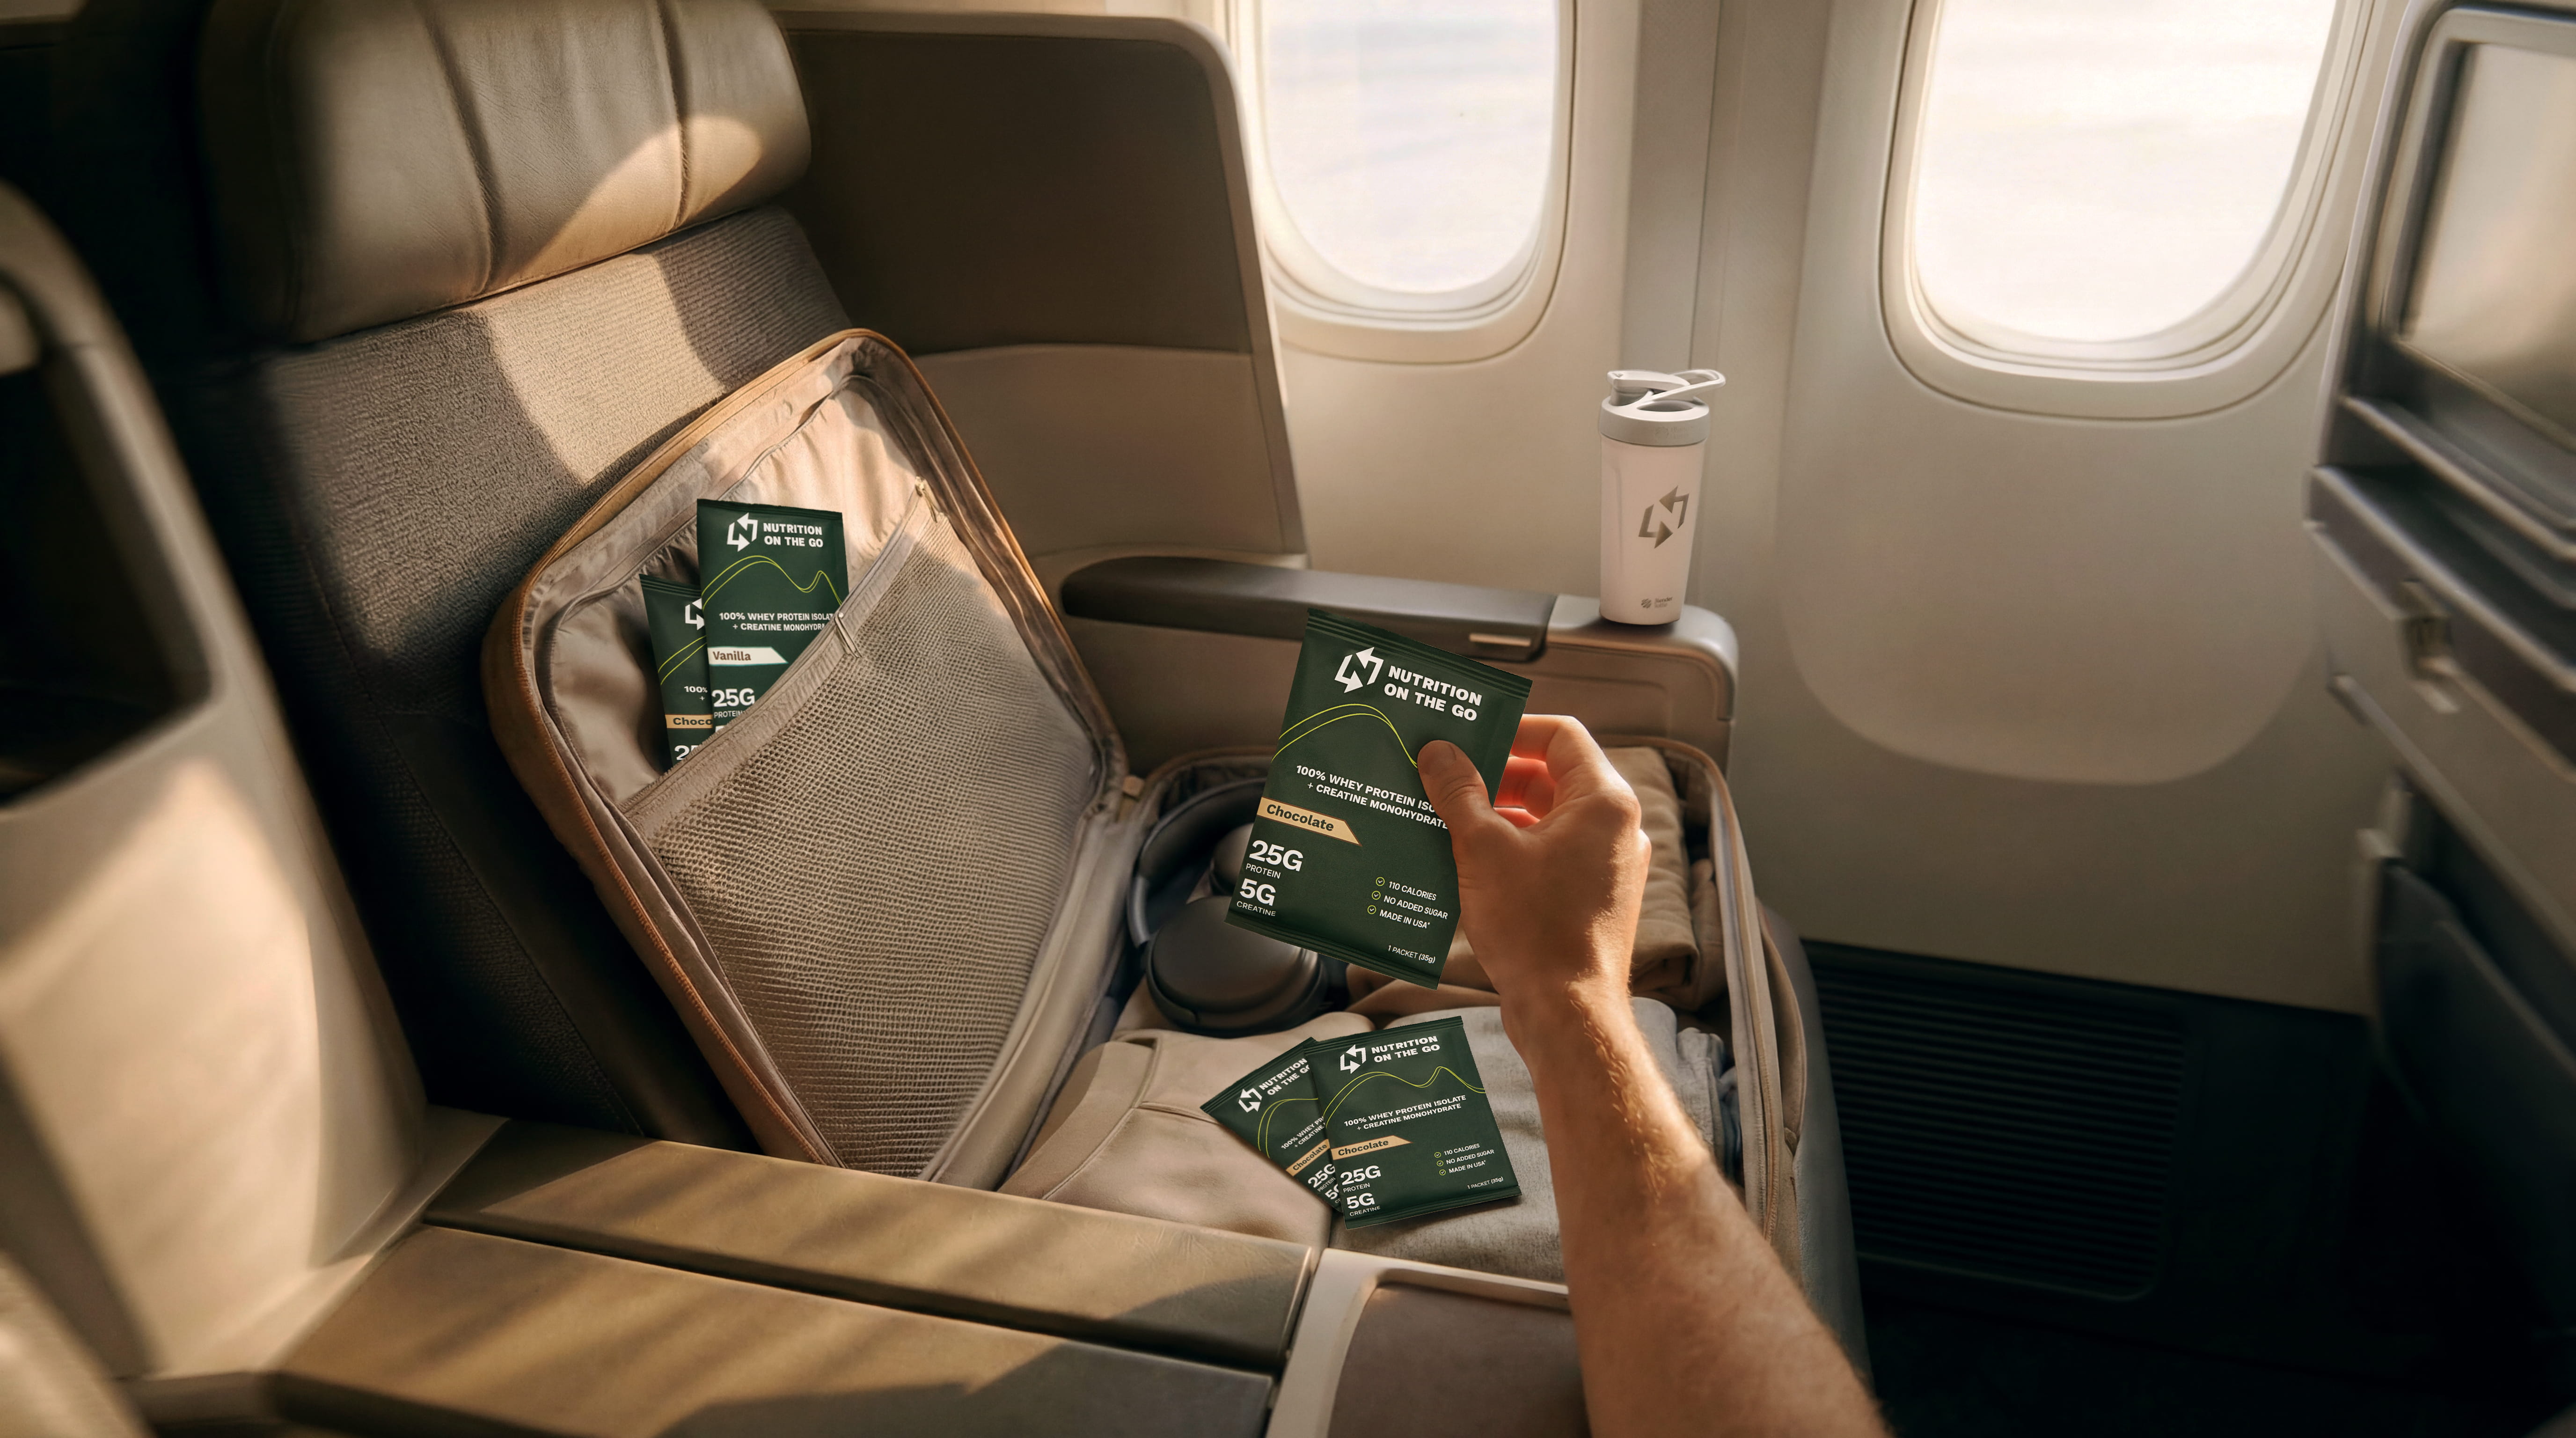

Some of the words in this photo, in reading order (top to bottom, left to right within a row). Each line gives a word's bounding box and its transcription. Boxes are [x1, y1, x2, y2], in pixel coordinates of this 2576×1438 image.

[763, 523, 822, 535] NUTRITION
[764, 536, 781, 545] ON
[784, 537, 805, 546] THE
[809, 538, 823, 547] GO
[713, 651, 751, 660] Vanilla
[1389, 666, 1482, 706] NUTRITION
[711, 688, 755, 707] 25G
[1384, 683, 1409, 700] ON
[1415, 692, 1445, 712] THE
[1452, 704, 1477, 720] GO
[1297, 765, 1325, 780] 100%
[1330, 774, 1363, 791] WHEY
[1365, 785, 1415, 807] PROTEIN
[1317, 784, 1367, 806] CREATINE
[1267, 805, 1333, 831] Chocolate
[1249, 841, 1303, 871] 25G
[1246, 864, 1281, 879] PROTEIN
[1240, 879, 1275, 906] 5G
[1402, 886, 1436, 900] CALORIES
[1237, 901, 1276, 916] CREATINE
[1380, 910, 1403, 922] MADE
[1384, 895, 1396, 904] NO
[1397, 900, 1423, 912] ADDED
[1424, 908, 1448, 919] SUGAR
[1392, 947, 1418, 958] PACKET
[1419, 954, 1435, 963] (35g)
[1371, 1036, 1437, 1053] NUTRITION
[1374, 1054, 1391, 1062] ON
[1395, 1049, 1418, 1058] THE
[1422, 1043, 1440, 1052] GO
[1259, 1058, 1308, 1091] NUTRITION
[1267, 1085, 1282, 1095] ON
[1282, 1073, 1299, 1085] THE
[1344, 1117, 1367, 1126] 100%
[1368, 1111, 1393, 1121] WHEY
[1396, 1103, 1432, 1115] PROTEIN
[1434, 1095, 1466, 1106] ISOLATE
[1364, 1117, 1401, 1129] CREATINE
[1403, 1104, 1461, 1120] MONOHYDRATE
[1281, 1137, 1298, 1149] 100%
[1298, 1123, 1315, 1137] WHEY
[1298, 1125, 1325, 1145] CREATINE
[1338, 1139, 1389, 1156] Chocolate
[1454, 1144, 1480, 1153] CALORIES
[1293, 1145, 1327, 1171] Chocolate
[1308, 1164, 1335, 1188] 25G
[1317, 1177, 1335, 1191] PROTEIN
[1340, 1166, 1381, 1185] 25G
[1343, 1183, 1370, 1192] PROTEIN
[1347, 1193, 1375, 1209] 5G
[1349, 1206, 1381, 1217] CREATINE
